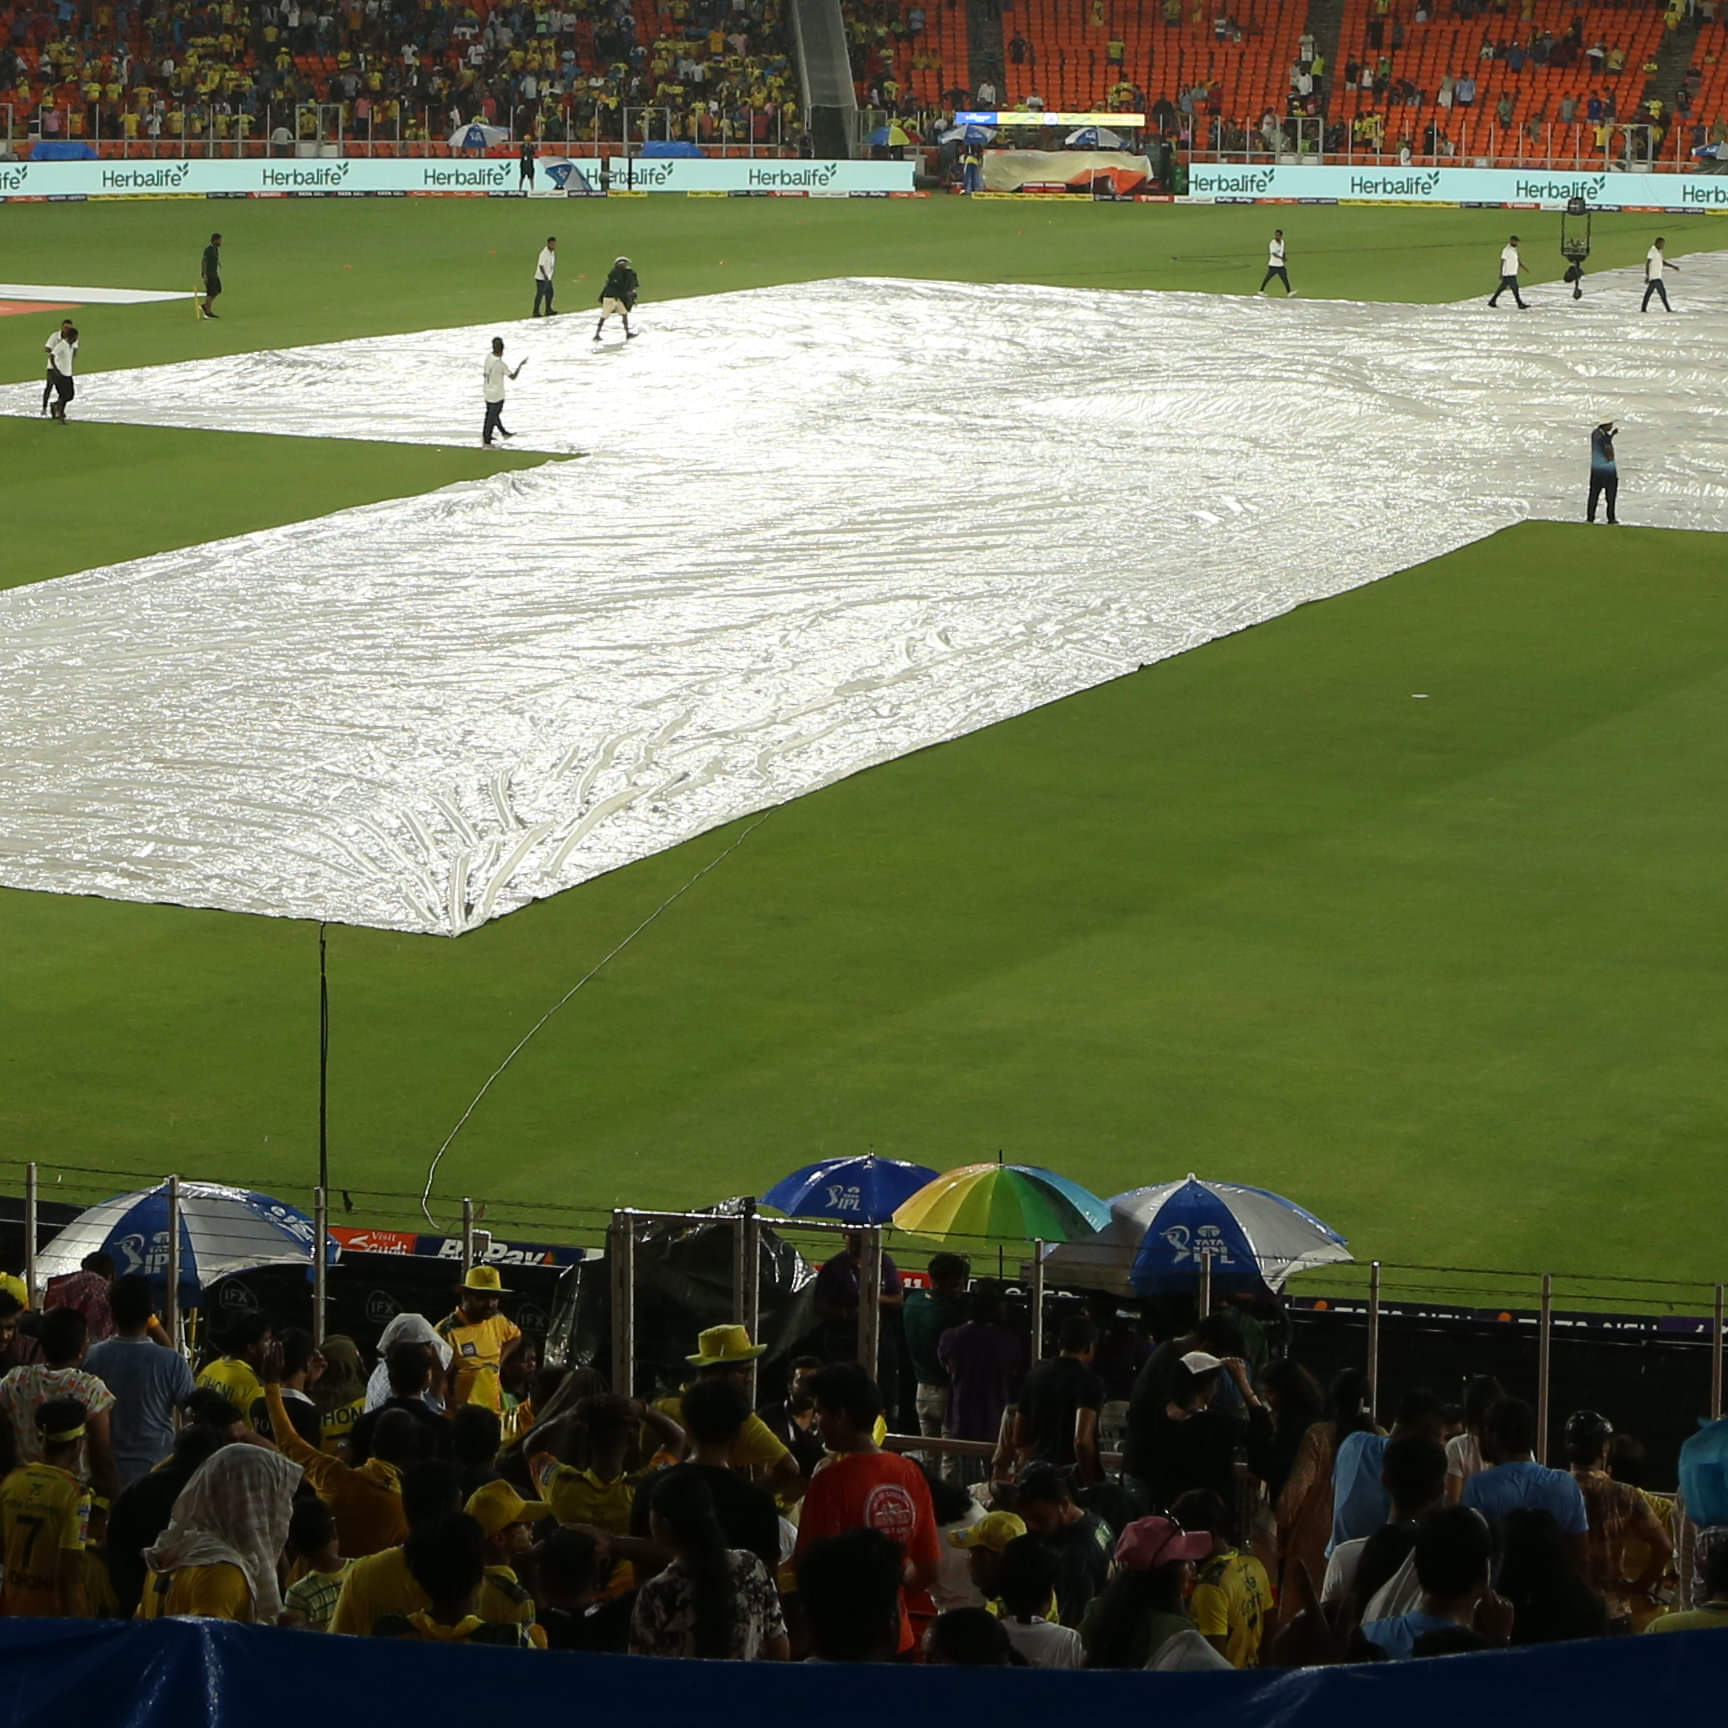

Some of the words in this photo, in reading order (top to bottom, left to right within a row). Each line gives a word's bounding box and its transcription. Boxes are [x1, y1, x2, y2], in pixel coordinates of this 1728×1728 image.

[102, 167, 187, 188] Herbalife
[262, 166, 347, 186] Herbalife
[424, 166, 510, 186] Herbalife
[749, 166, 834, 186] Herbalife
[1187, 172, 1273, 196] Herbalife
[1351, 174, 1435, 195] Herbalife
[1516, 177, 1600, 198] Herbalife
[837, 1197, 861, 1212] IPL
[372, 1230, 397, 1243] Visit
[1193, 1238, 1225, 1249] TATA
[436, 1238, 547, 1265] RPay
[224, 1288, 248, 1304] IFX
[372, 1303, 395, 1316] IFX
[15, 1515, 45, 1569] 7
